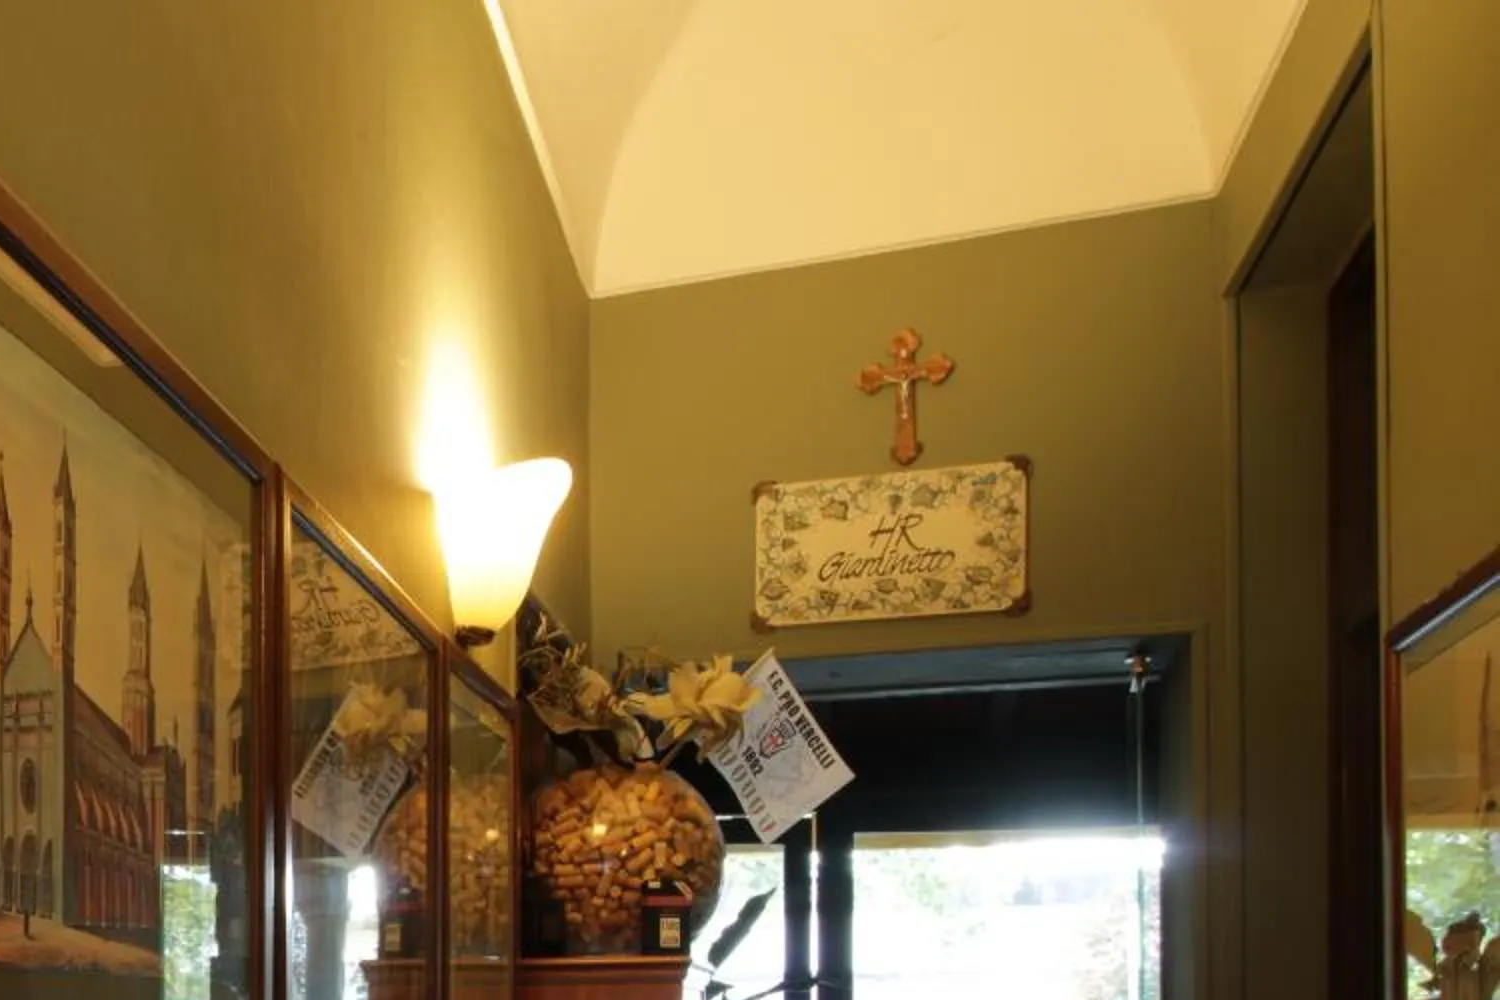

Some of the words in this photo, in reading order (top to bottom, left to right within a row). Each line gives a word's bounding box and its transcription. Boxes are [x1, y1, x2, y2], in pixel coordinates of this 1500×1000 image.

[779, 690, 801, 717] PRO
[795, 713, 836, 769] VERCELLI
[742, 745, 764, 778] 1892
